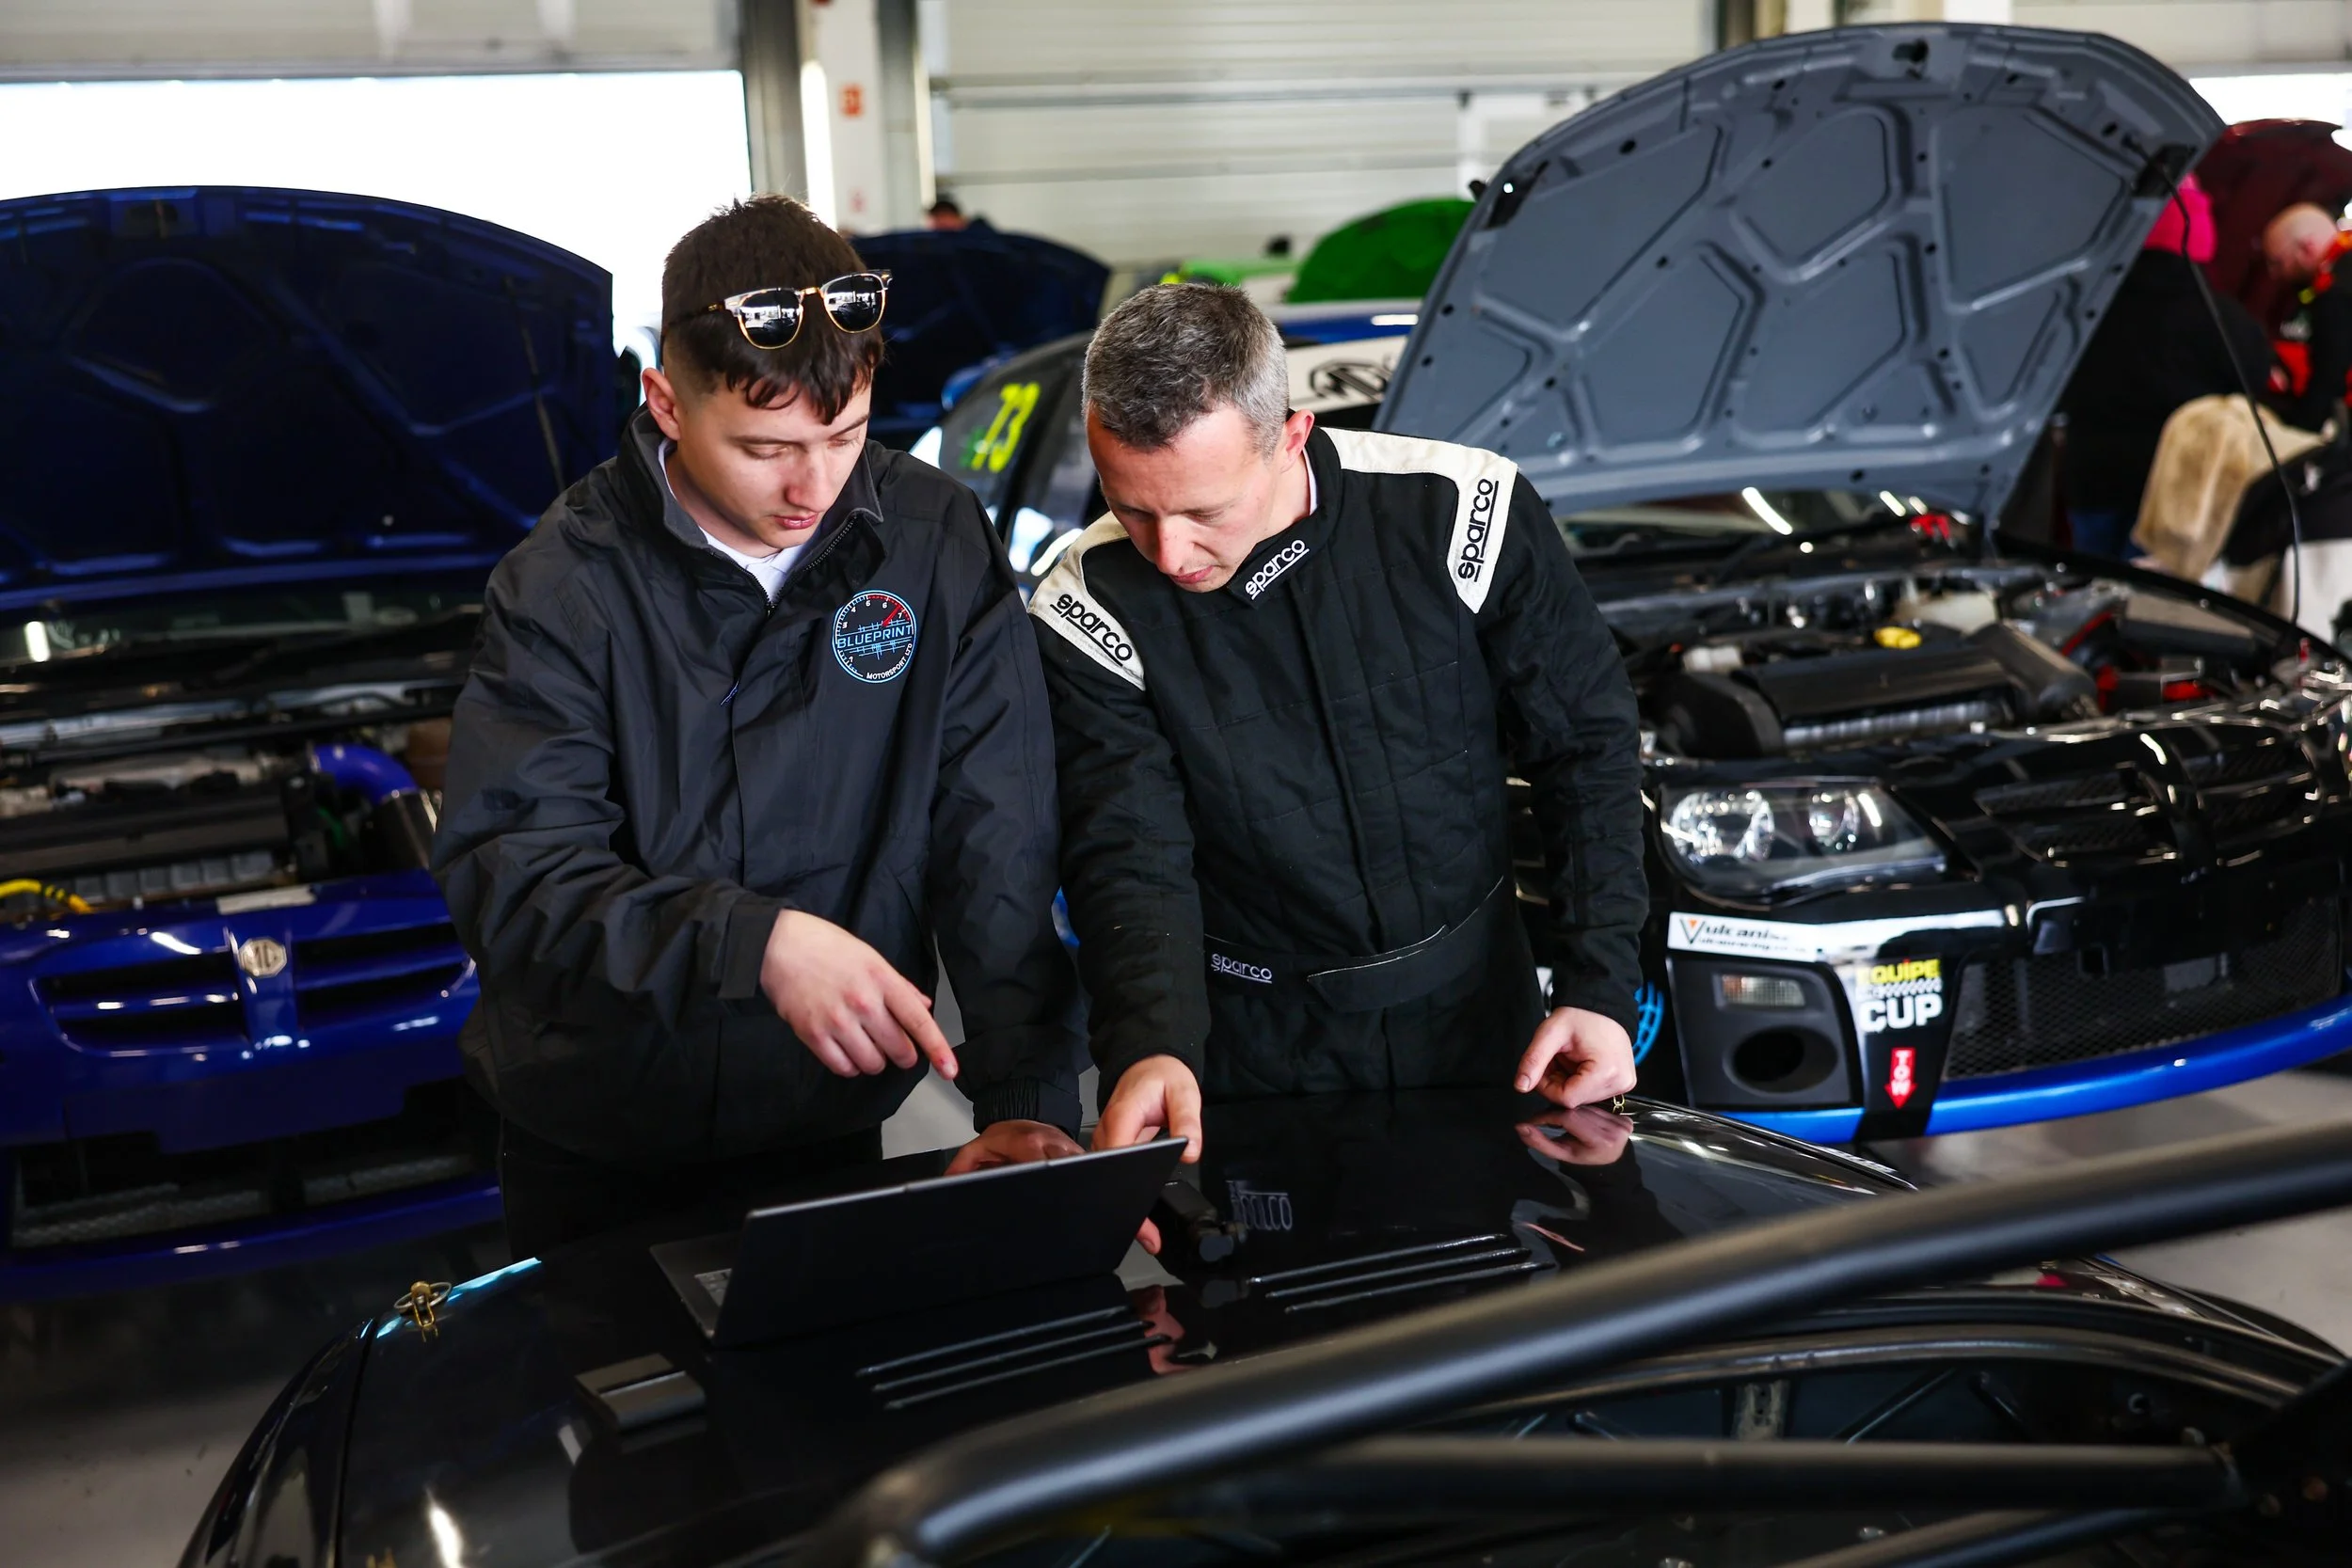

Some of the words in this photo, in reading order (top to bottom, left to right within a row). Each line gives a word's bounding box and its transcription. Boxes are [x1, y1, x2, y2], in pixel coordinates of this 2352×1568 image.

[1458, 478, 1500, 582] sparco
[1245, 539, 1310, 600] sparco
[837, 626, 913, 648] BLUEPRINT
[1050, 594, 1133, 667] sparco
[866, 657, 907, 679] MOTORSPORT
[1211, 953, 1273, 984] sparco
[1859, 993, 1943, 1034] CUP
[1891, 1049, 1913, 1096] TOW
